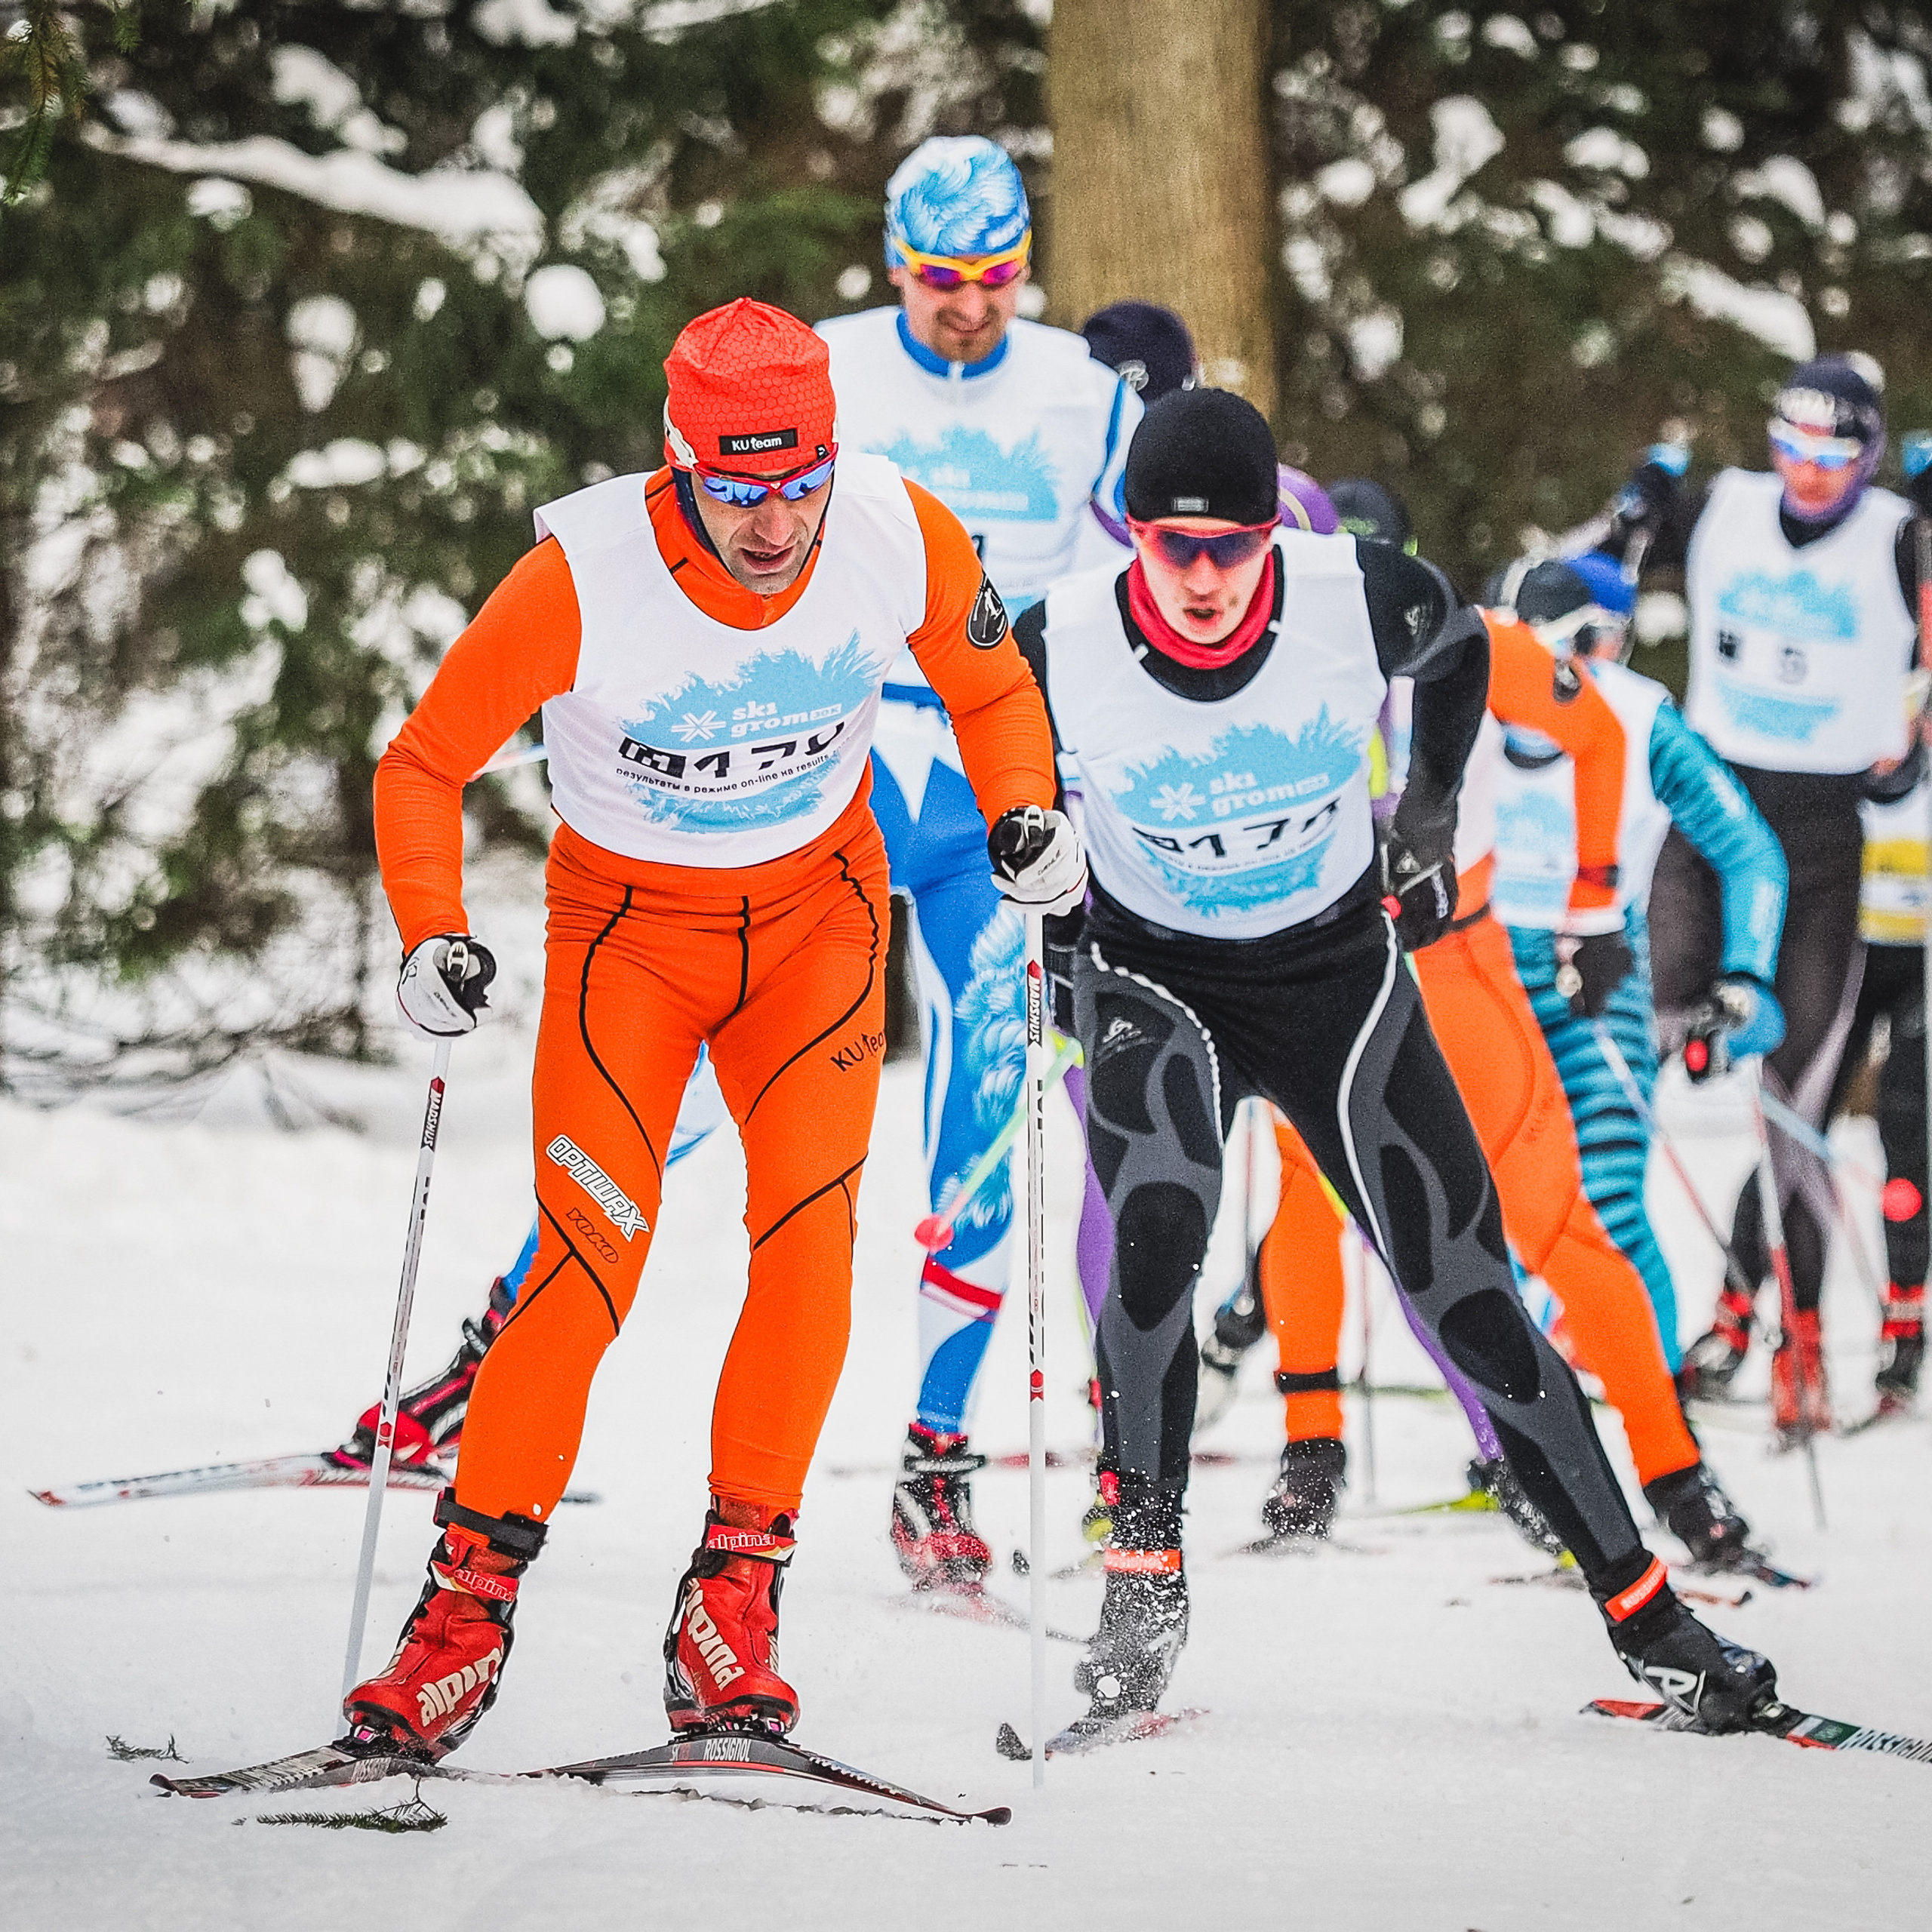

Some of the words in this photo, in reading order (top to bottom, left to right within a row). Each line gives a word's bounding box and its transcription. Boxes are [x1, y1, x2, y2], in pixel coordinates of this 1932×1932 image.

[731, 439, 749, 451] KU
[750, 437, 782, 451] team
[732, 701, 777, 721] ski
[731, 712, 808, 737] grom
[741, 772, 779, 788] on-line
[1028, 974, 1041, 1043] MADSHUS
[830, 1041, 864, 1072] KU
[423, 1087, 442, 1147] MADSHUS
[546, 1135, 649, 1240] OPTIWAX
[566, 1208, 619, 1263] YOKO
[706, 1532, 776, 1551] alpina
[703, 1737, 752, 1762] ROSSIGNOL
